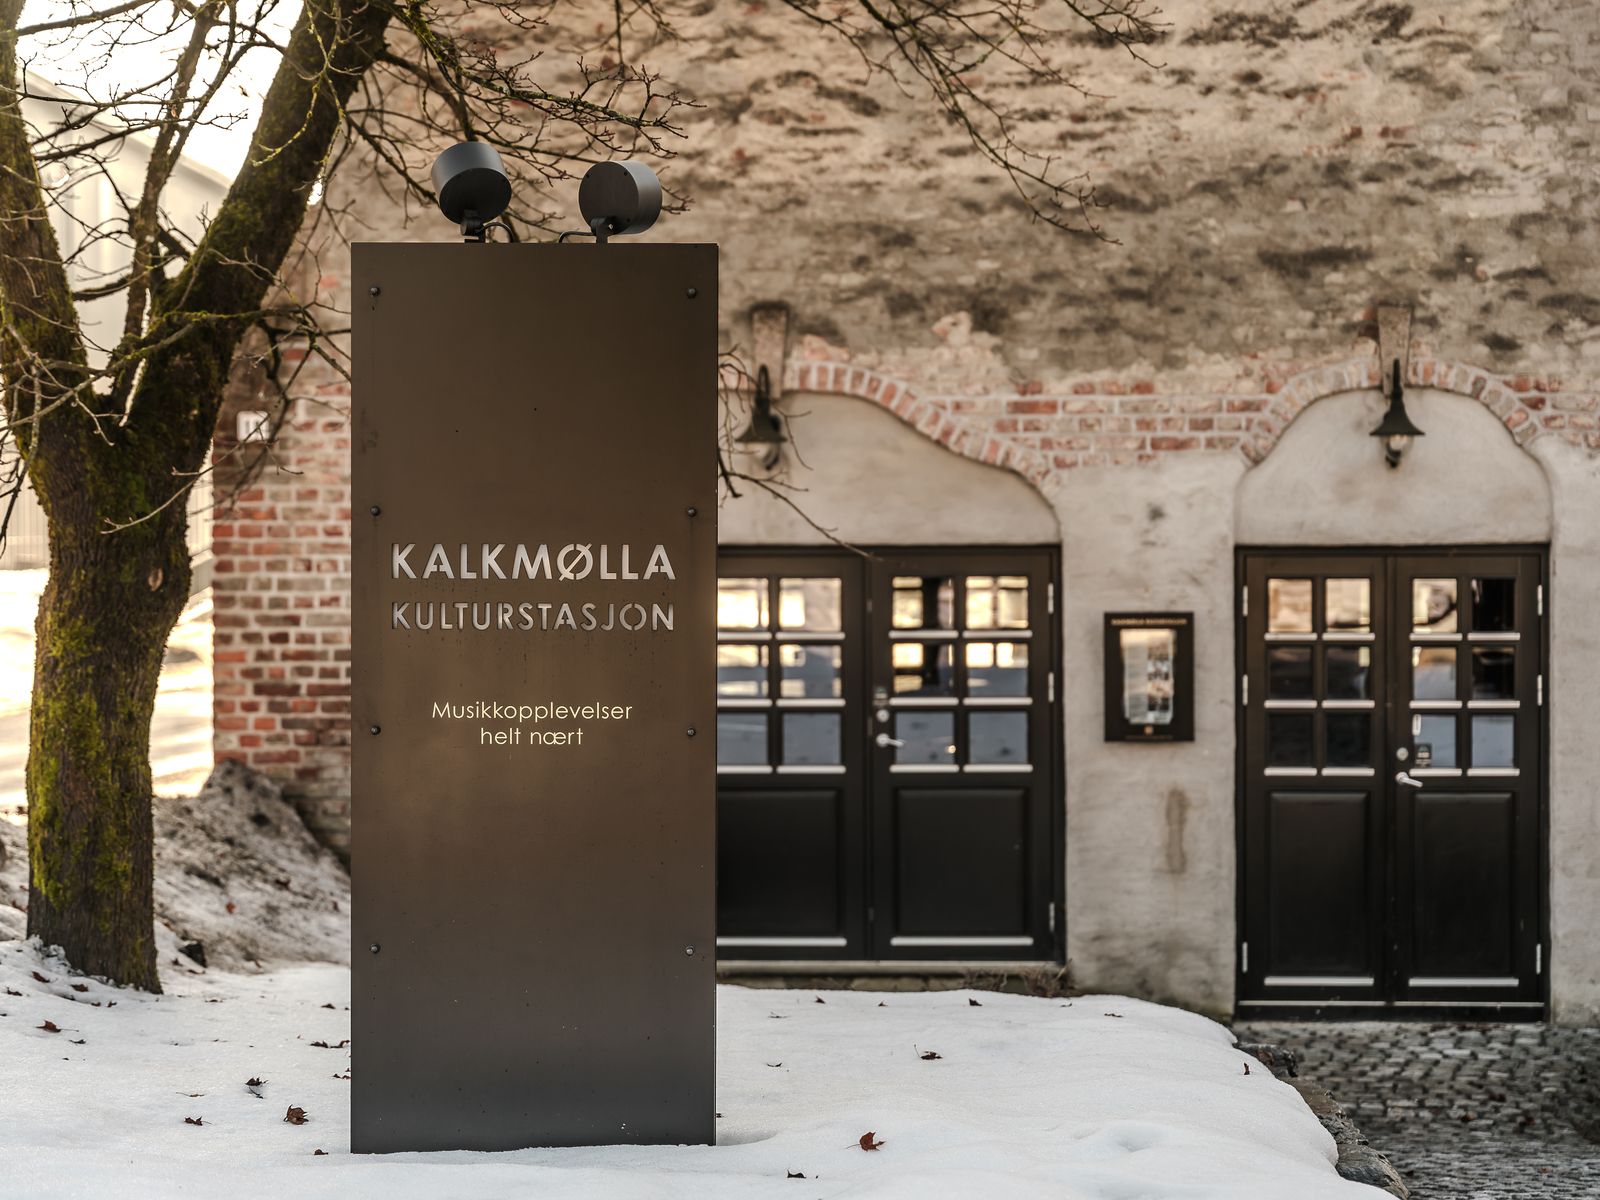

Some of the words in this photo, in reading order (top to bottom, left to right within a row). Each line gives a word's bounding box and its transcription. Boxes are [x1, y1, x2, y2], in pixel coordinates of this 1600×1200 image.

[391, 543, 676, 582] KALKMØLLA
[391, 602, 675, 631] KULTURSTASJON
[432, 702, 633, 723] Musikkopplevelser
[480, 727, 521, 745] helt
[530, 728, 584, 745] nært
